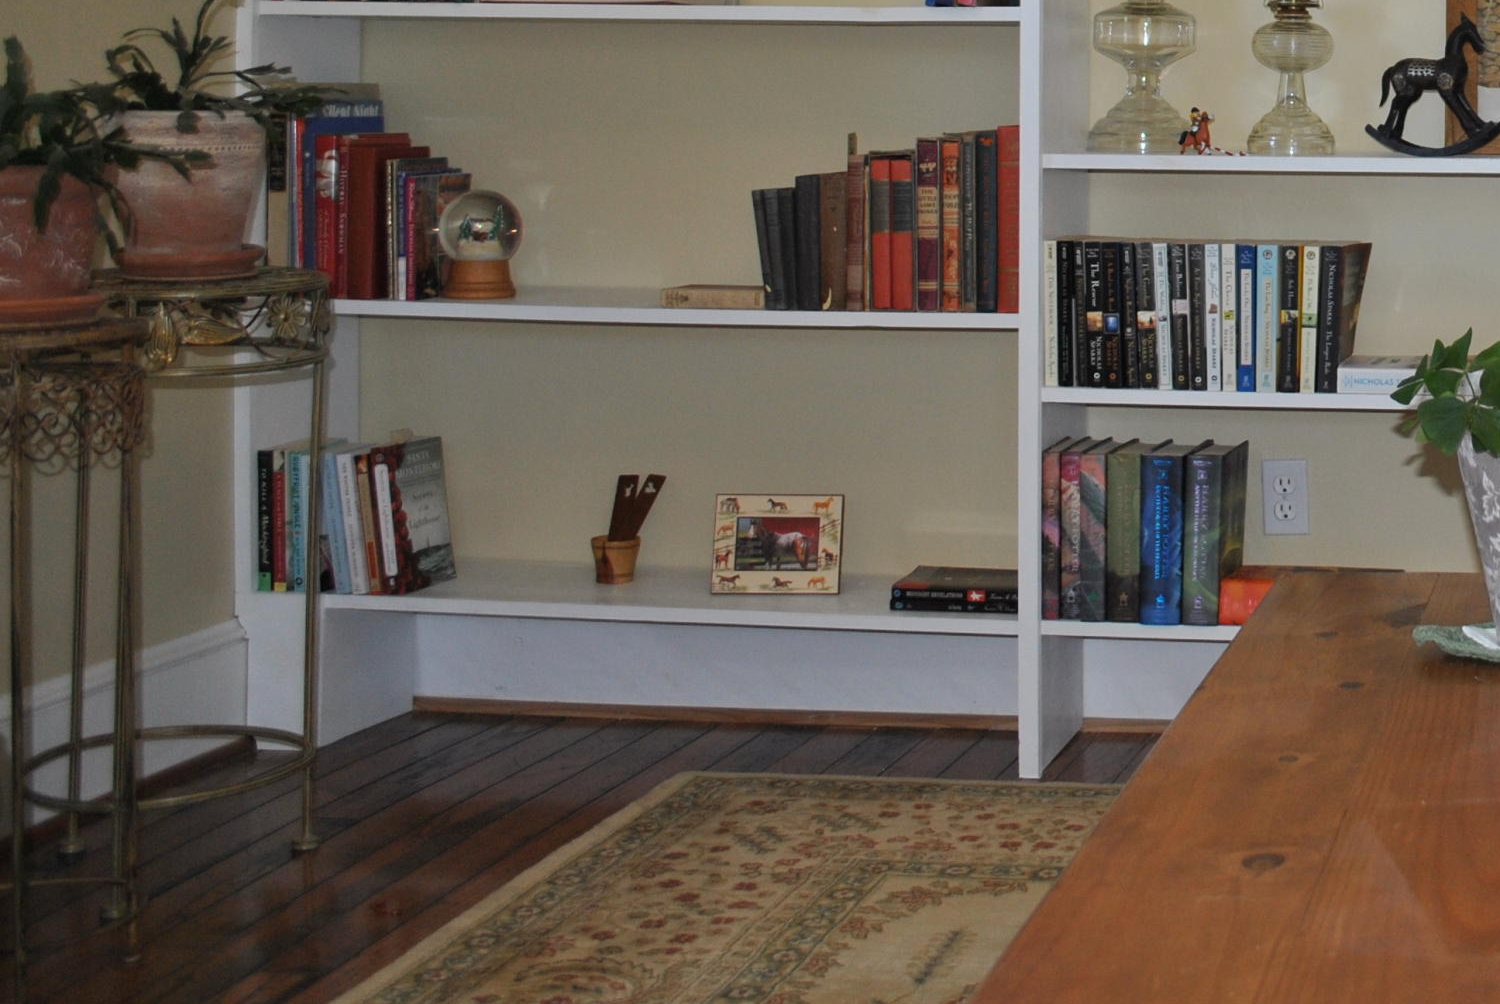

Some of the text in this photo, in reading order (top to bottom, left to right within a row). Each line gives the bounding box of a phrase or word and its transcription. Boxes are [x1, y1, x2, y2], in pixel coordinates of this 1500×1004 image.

[322, 104, 380, 118] Silent Night
[1091, 262, 1101, 308] The Rescue
[1124, 276, 1135, 326] Nights Rodanthe
[1142, 263, 1153, 308] The Guardian
[1175, 273, 1186, 299] Believer
[1192, 275, 1202, 309] First Sight
[1206, 261, 1219, 301] Dear John
[1224, 270, 1233, 307] The Choice
[1264, 281, 1272, 292] The
[1287, 290, 1295, 308] Haven
[1326, 264, 1337, 326] NICHOLAS SPARKS
[1090, 339, 1099, 367] SPARKS
[1096, 336, 1104, 371] NICHOLAS
[1127, 340, 1138, 387] NICHOLAS SPARKS
[1142, 338, 1150, 364] SPARKS
[1147, 333, 1157, 369] NICHOLAS
[1177, 317, 1187, 373] NICHOLAS SPARKS
[1194, 315, 1203, 371] NICHOLAS SPARKS
[1210, 317, 1220, 371] NICHOLAS SPARKS
[1323, 330, 1335, 375] The Longest Ride
[1353, 378, 1394, 387] NICHOLAS
[261, 480, 269, 501] KILL
[292, 456, 303, 529] RUBYFRUIT JUNGLE
[1200, 484, 1211, 530] HARRY
[259, 515, 271, 565] Mockingbird
[1070, 528, 1081, 574] POTTER
[1160, 484, 1171, 580] HARRY POTTER
